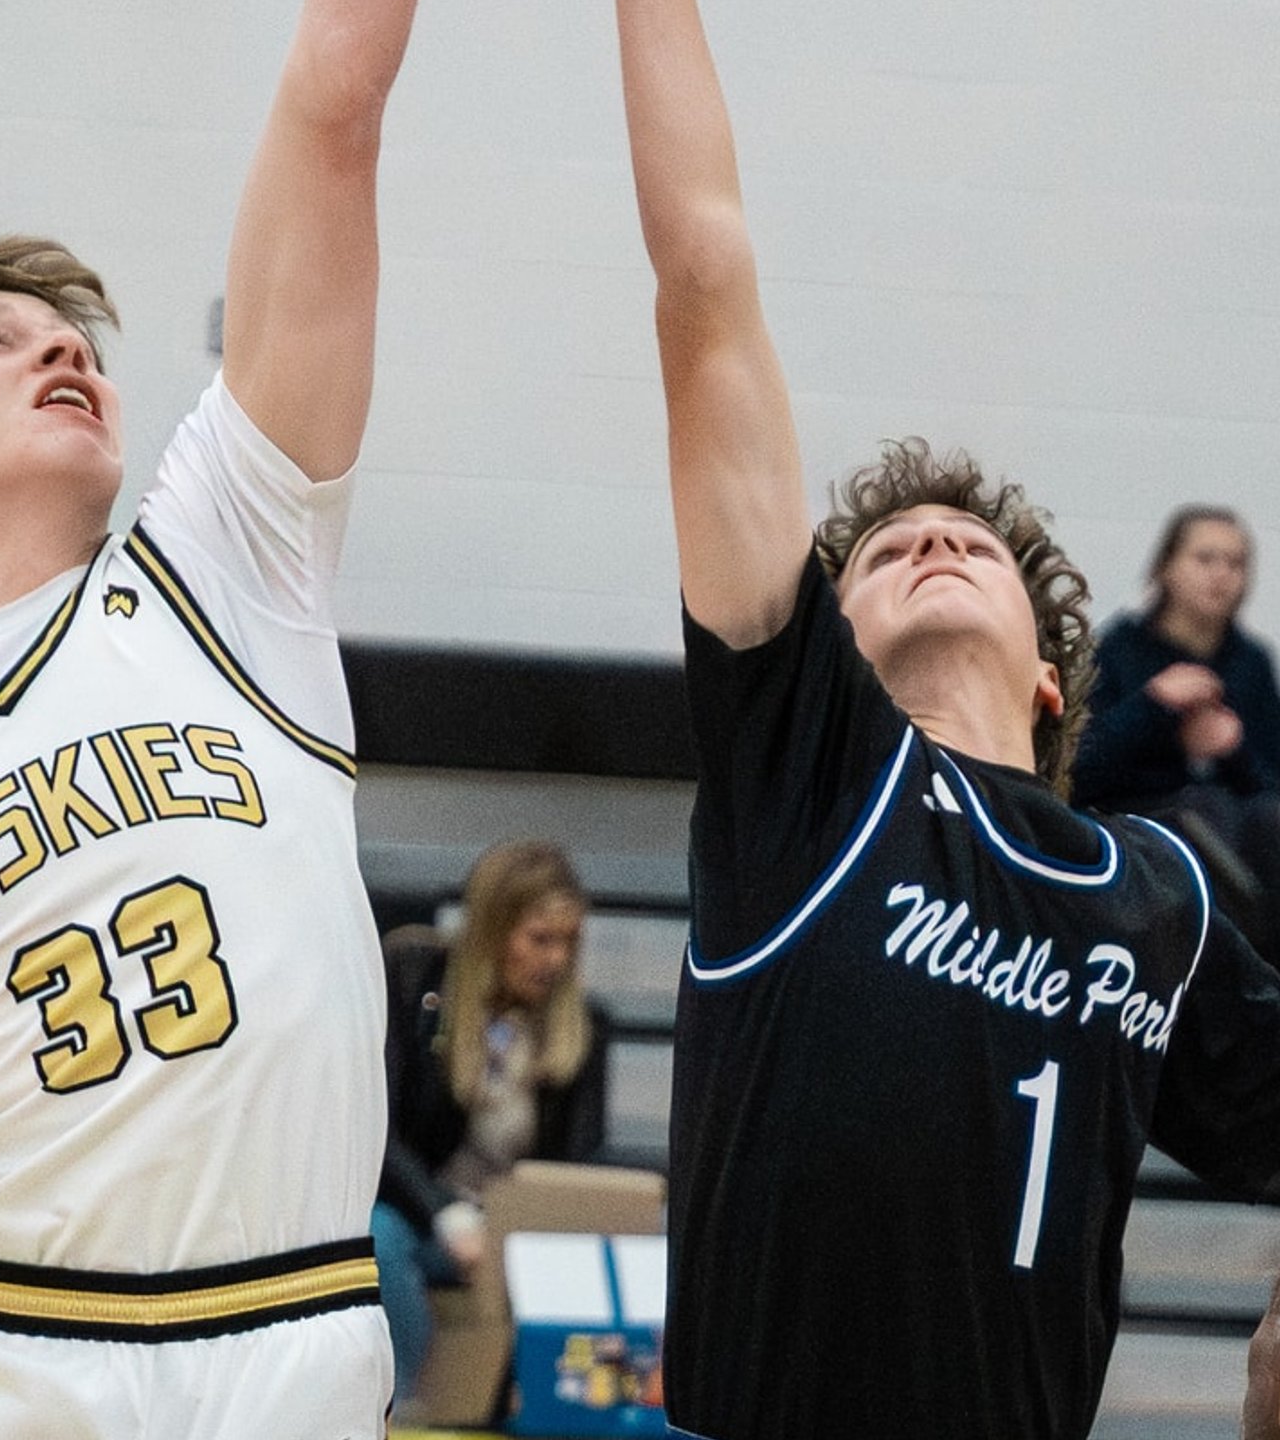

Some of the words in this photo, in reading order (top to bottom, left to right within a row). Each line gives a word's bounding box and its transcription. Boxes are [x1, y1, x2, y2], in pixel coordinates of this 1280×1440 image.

[6, 874, 239, 1095] 33
[885, 882, 1071, 1018] Middle
[1012, 1060, 1062, 1269] 1
